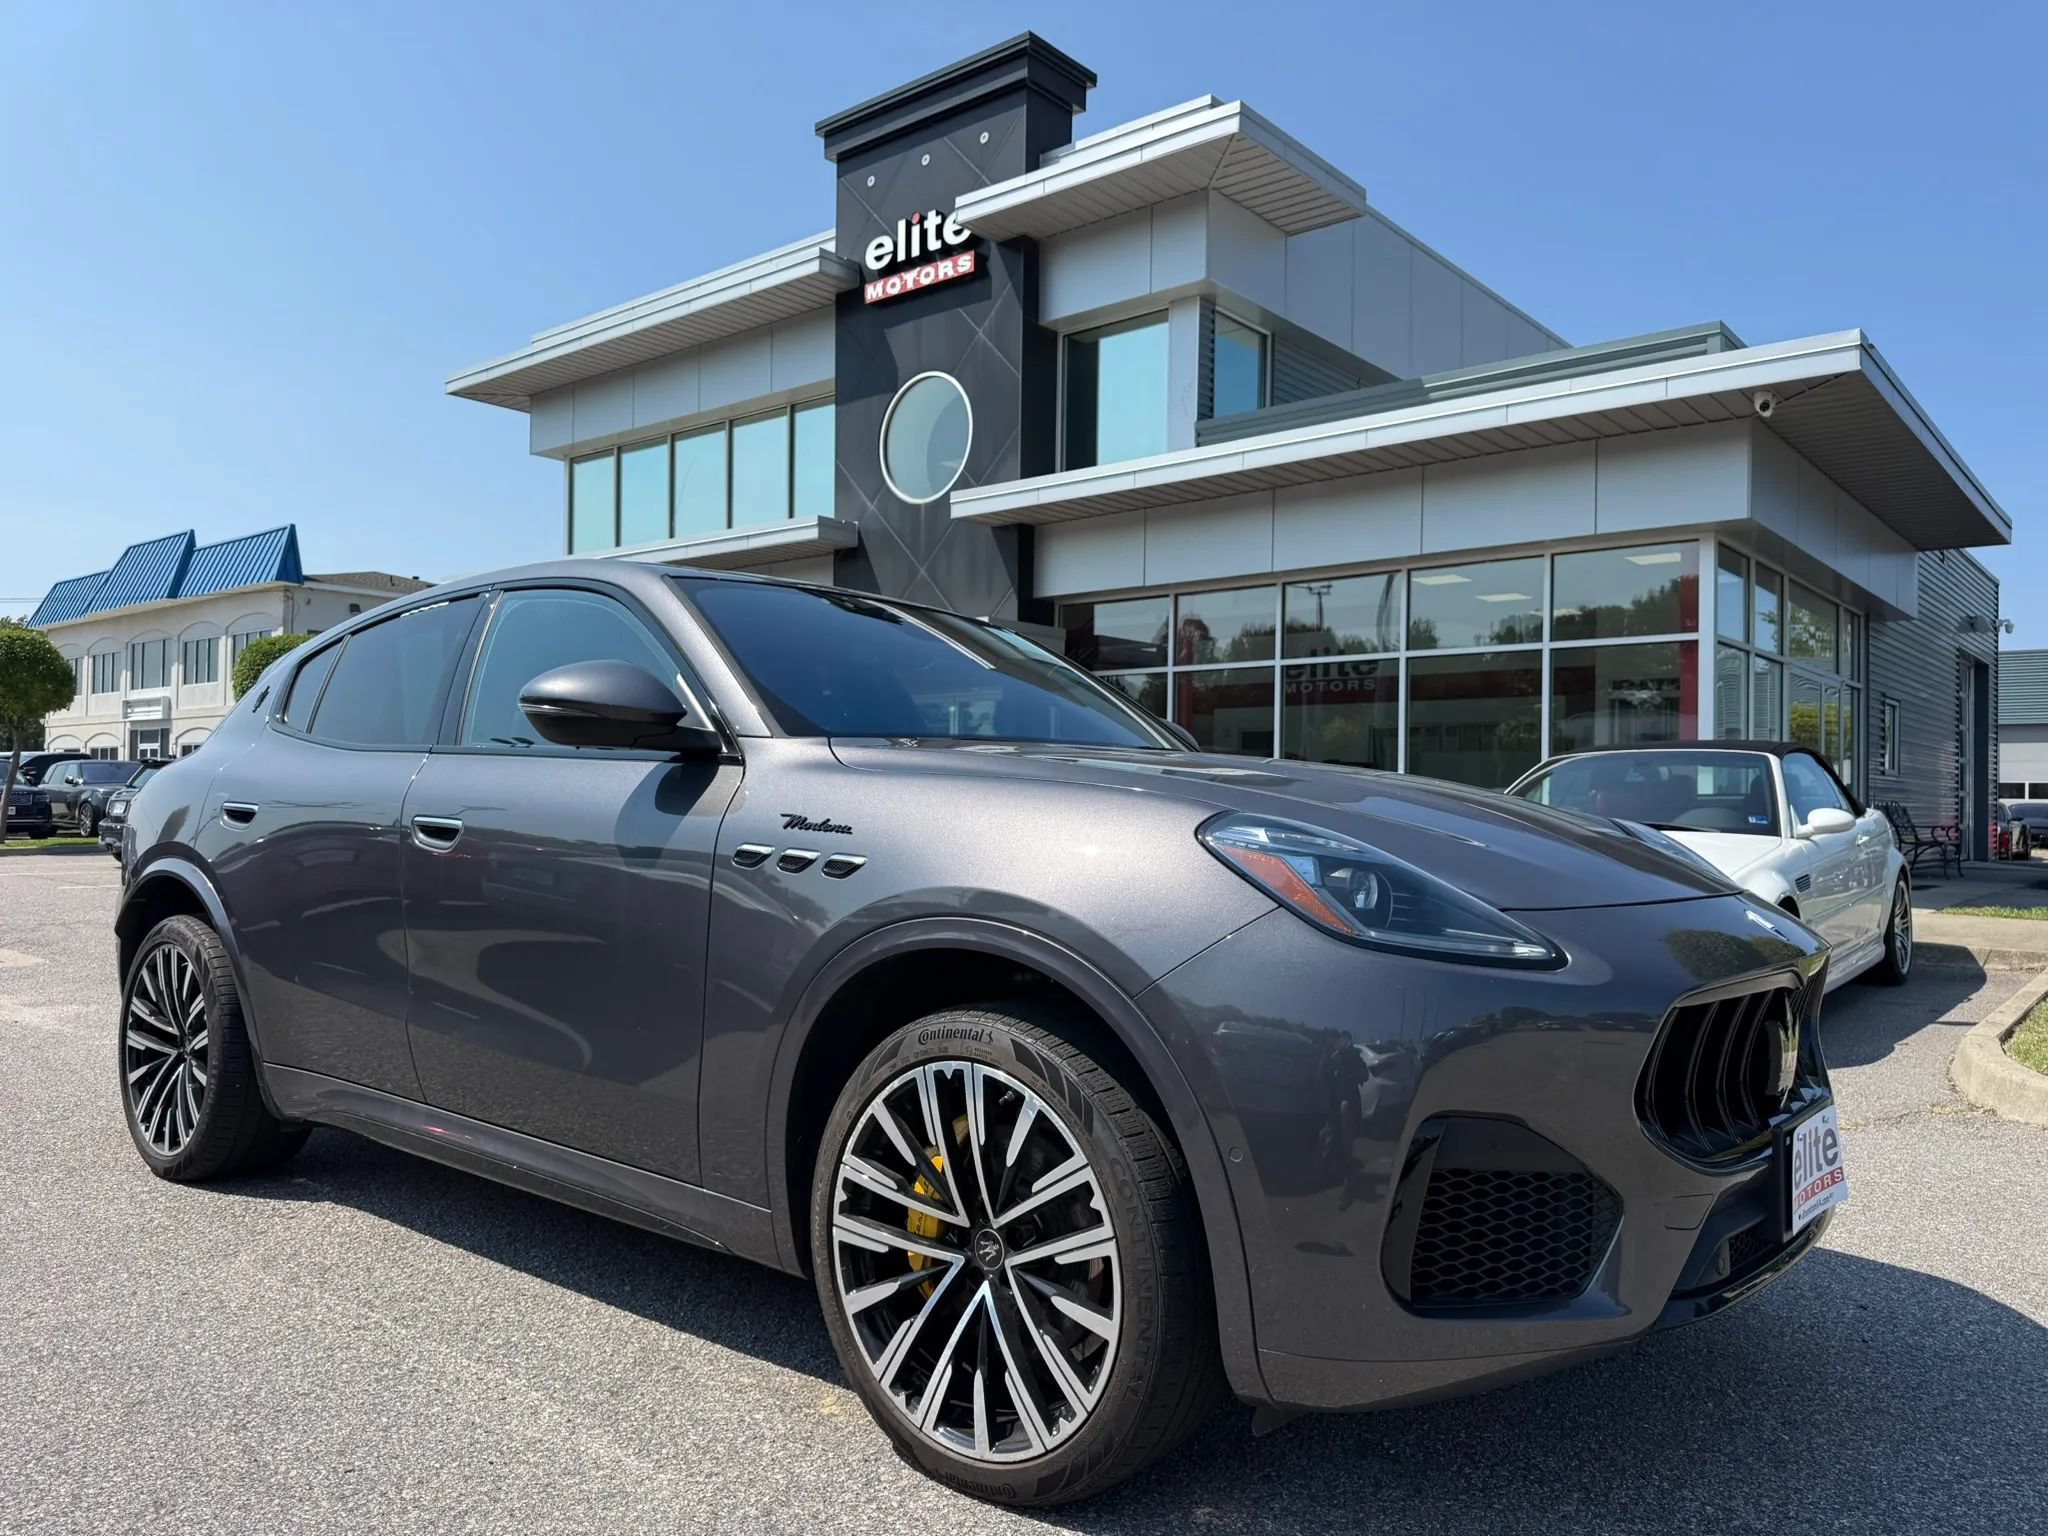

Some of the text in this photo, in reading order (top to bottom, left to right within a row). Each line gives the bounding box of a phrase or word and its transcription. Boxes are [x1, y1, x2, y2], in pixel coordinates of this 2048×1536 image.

[865, 209, 972, 270] elite
[866, 254, 973, 300] MOTORS
[1286, 680, 1376, 694] MOTORS
[780, 813, 853, 835] Modena
[918, 1026, 984, 1045] Continental
[1794, 1126, 1838, 1191] elite
